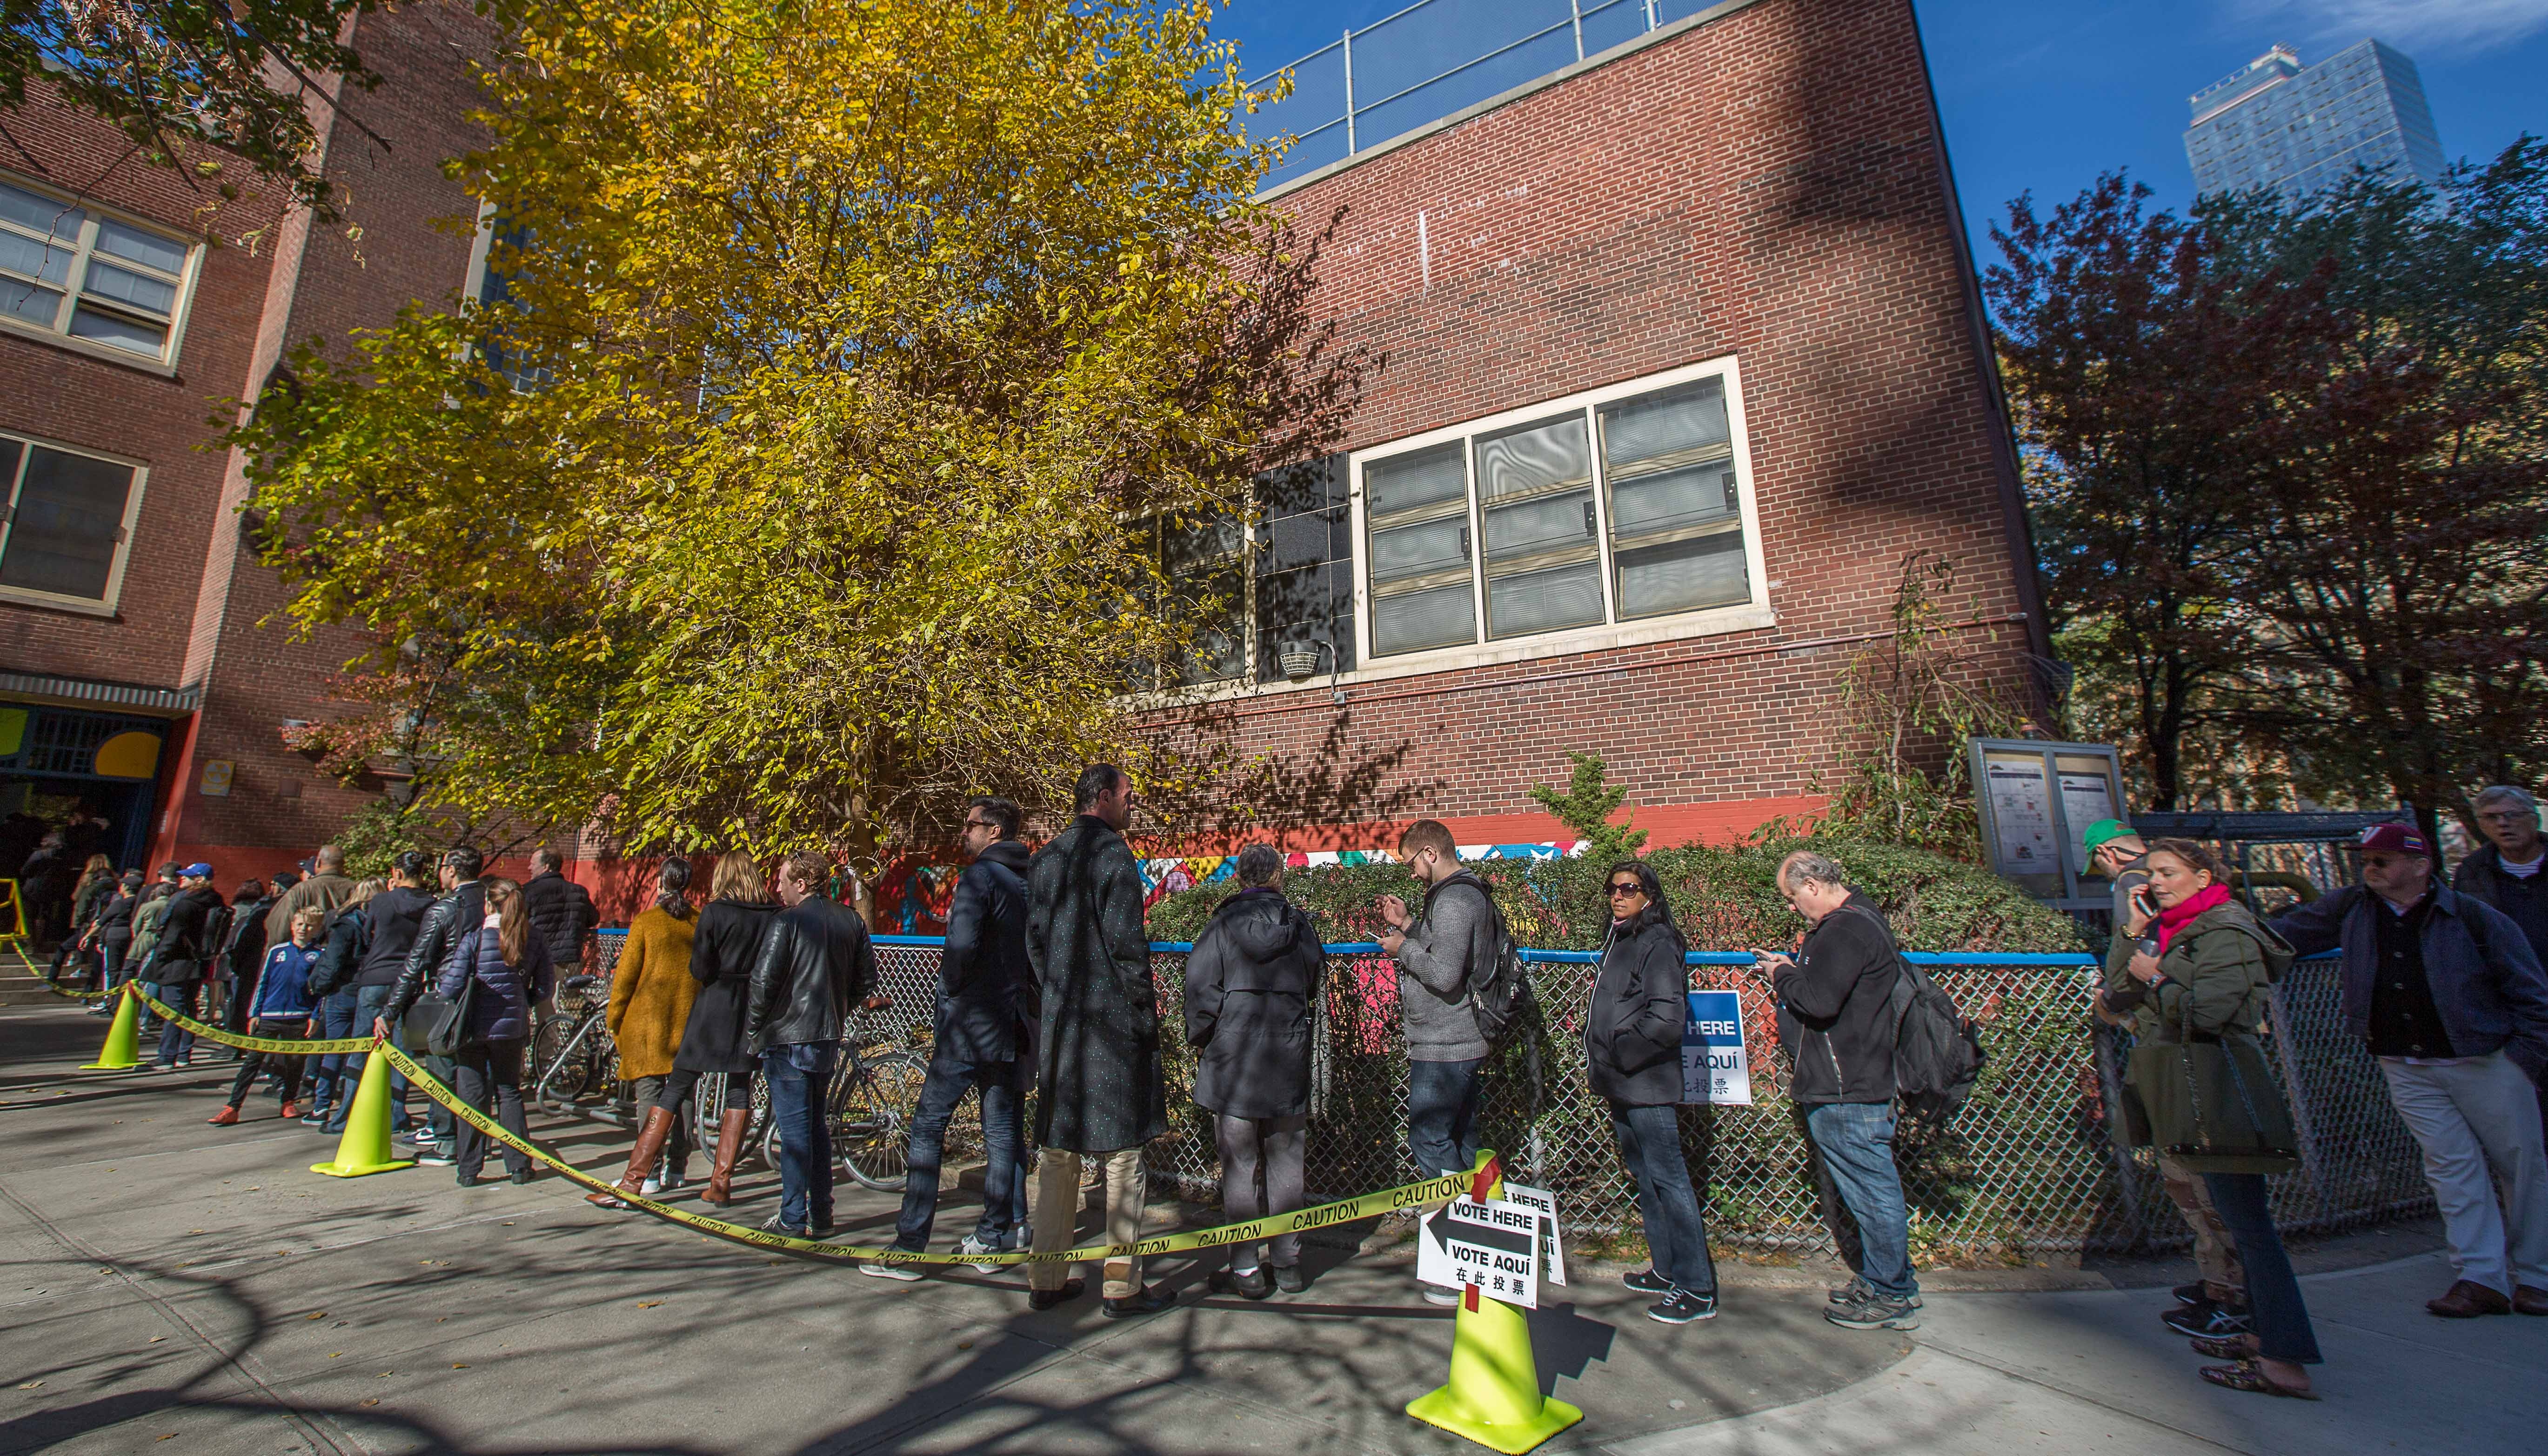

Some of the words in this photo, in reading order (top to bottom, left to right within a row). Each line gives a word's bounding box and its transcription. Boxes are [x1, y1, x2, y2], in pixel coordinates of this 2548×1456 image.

[1687, 1021, 1736, 1035] HERE
[1694, 1052, 1738, 1069] AQUÍ
[1685, 1077, 1729, 1095] 投票
[389, 1052, 418, 1077] CAUTION
[423, 1080, 453, 1105] CAUTION
[460, 1108, 491, 1130] CAUTION
[688, 1216, 730, 1232] CAUTION
[744, 1232, 790, 1246] CAUTION
[805, 1244, 856, 1256] CAUTION
[875, 1253, 927, 1262] CAUTION
[1025, 1251, 1083, 1262] CAUTION
[1109, 1239, 1170, 1257] CAUTION
[1197, 1223, 1262, 1247] CAUTION
[1293, 1201, 1359, 1230] CAUTION
[1393, 1175, 1465, 1207] CAUTION
[1511, 1193, 1550, 1213] HERE
[1453, 1202, 1489, 1222] VOTE
[1493, 1209, 1532, 1229] HERE
[1539, 1239, 1555, 1256] UÍ
[1452, 1245, 1489, 1266] VOTE
[1493, 1255, 1531, 1276] AQUÍ
[1456, 1267, 1524, 1296] 在此投票
